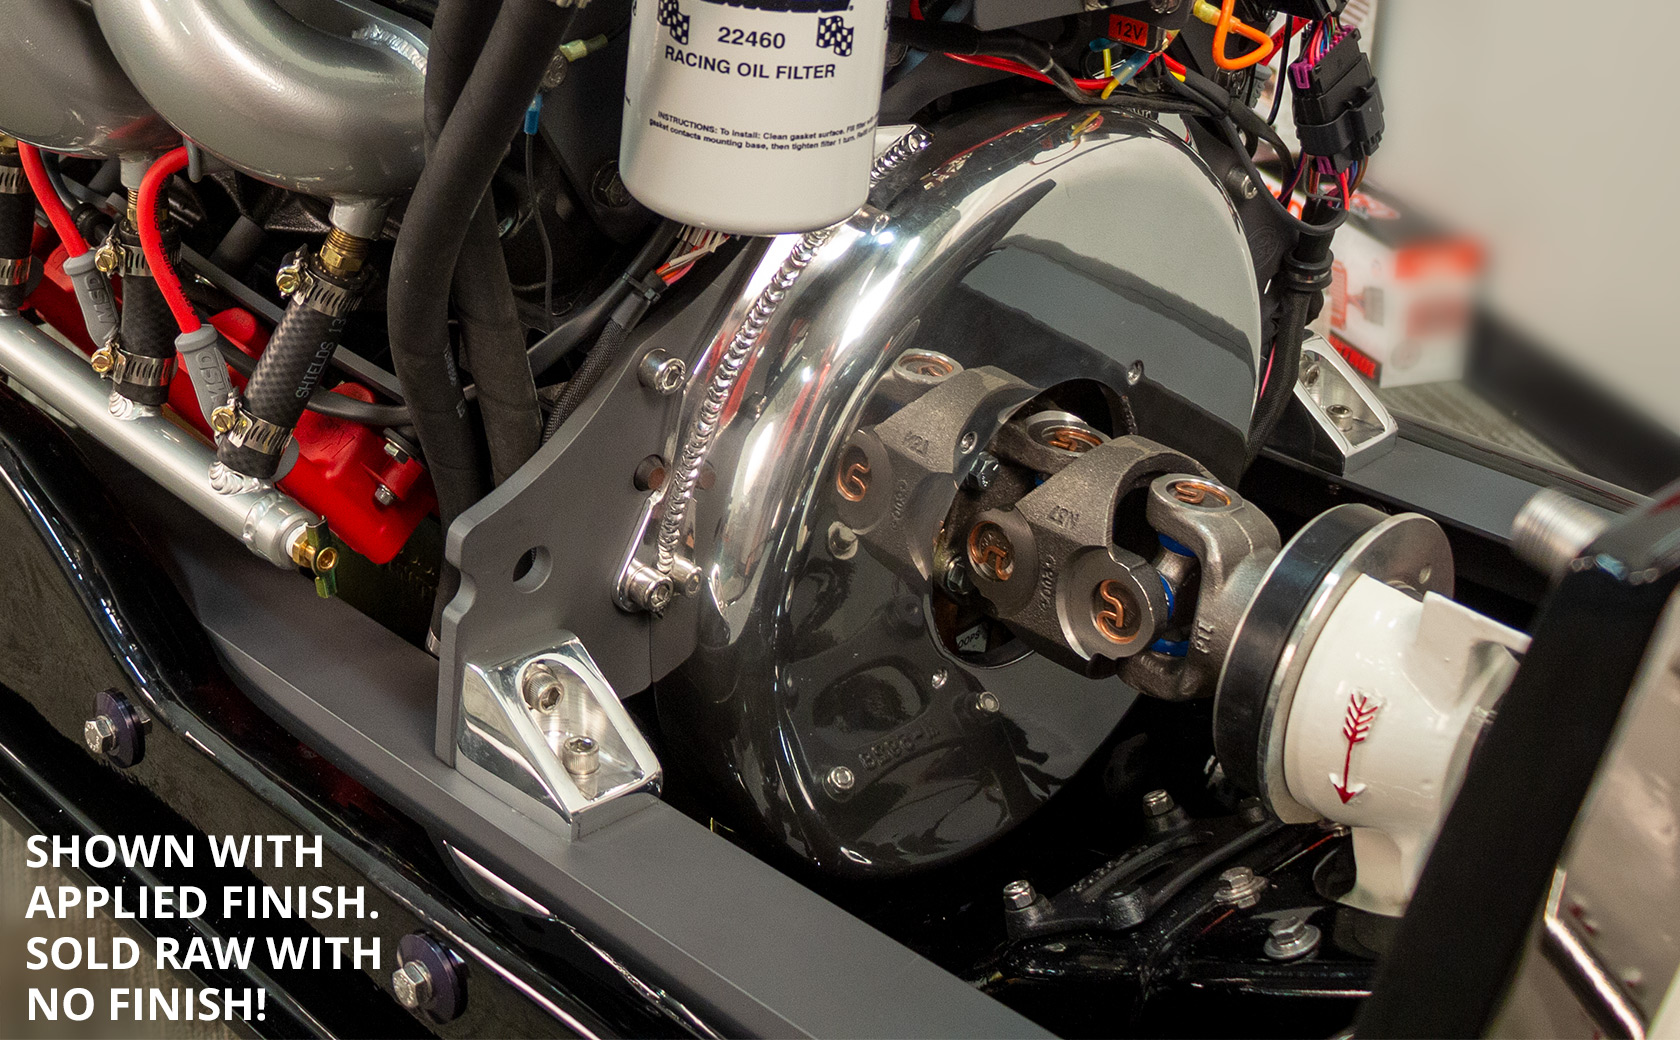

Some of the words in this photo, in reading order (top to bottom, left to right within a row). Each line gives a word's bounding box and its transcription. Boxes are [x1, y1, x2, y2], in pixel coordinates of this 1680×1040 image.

[717, 26, 786, 49] 22460
[1116, 20, 1143, 40] 12V
[664, 45, 731, 74] RACING
[737, 62, 770, 79] OIL
[776, 63, 836, 79] FILTER
[657, 111, 718, 134] INSTRUCTIONS:
[720, 127, 730, 136] To
[763, 132, 788, 140] Clean
[790, 133, 817, 142] gasket
[670, 127, 701, 141] contacts
[703, 135, 743, 149] mounting
[745, 141, 769, 150] base,
[792, 143, 819, 151] tighten
[83, 272, 112, 324] MSD
[195, 350, 227, 409] MSD
[295, 341, 334, 398] SHIELDS
